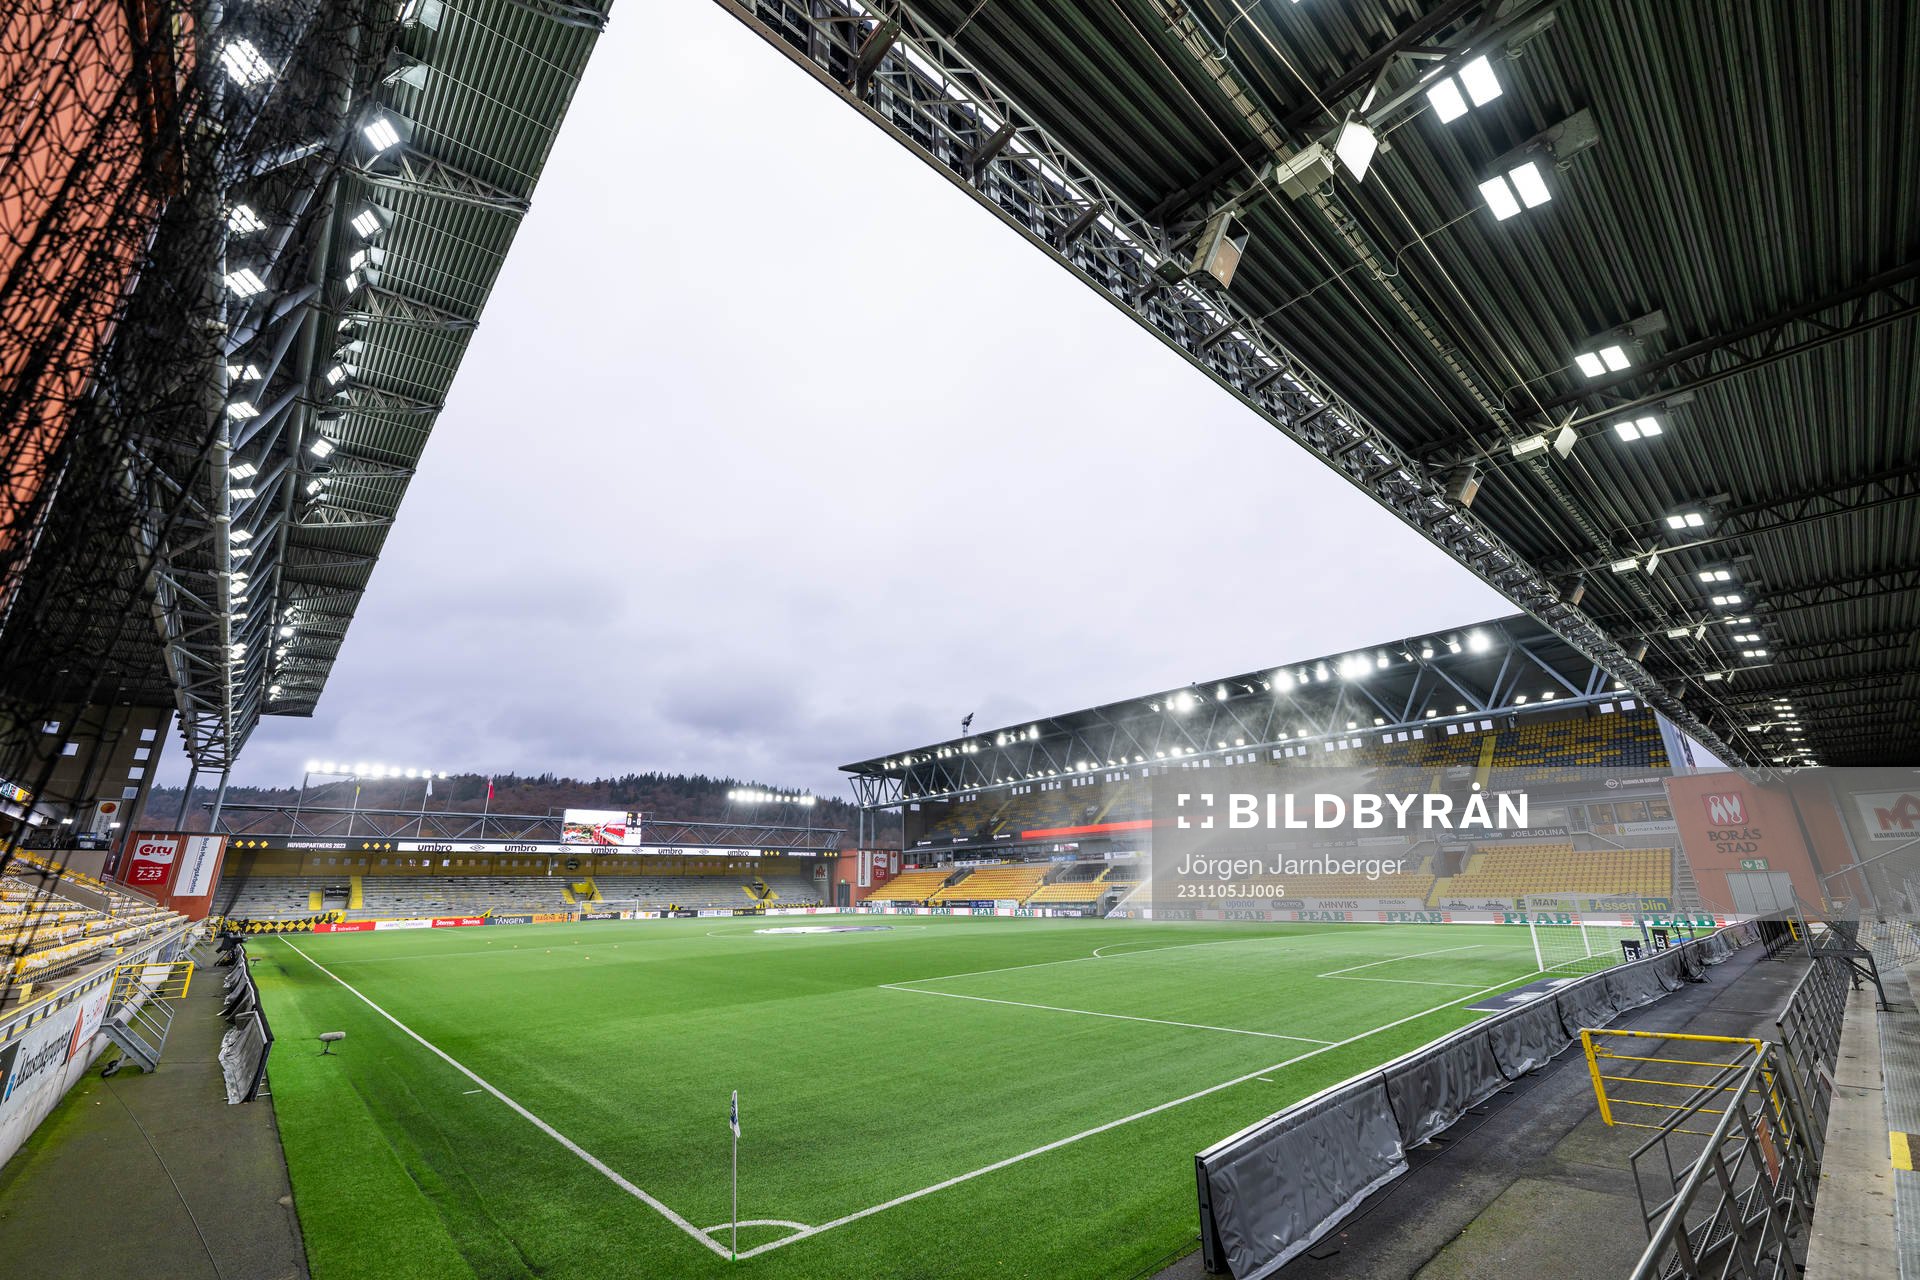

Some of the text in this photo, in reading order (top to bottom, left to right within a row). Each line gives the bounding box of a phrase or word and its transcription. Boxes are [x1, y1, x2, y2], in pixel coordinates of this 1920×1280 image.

[1511, 828, 1565, 838] JOELJOLINA
[1707, 827, 1762, 841] BORÅS
[417, 843, 452, 852] umbro
[504, 844, 538, 852] umbro
[590, 846, 618, 854] umbro
[658, 847, 684, 855] umbro
[1716, 842, 1758, 854] STAD
[1224, 911, 1265, 920] PEAB
[1298, 911, 1346, 921] PEAB
[1386, 911, 1443, 923] PEAB
